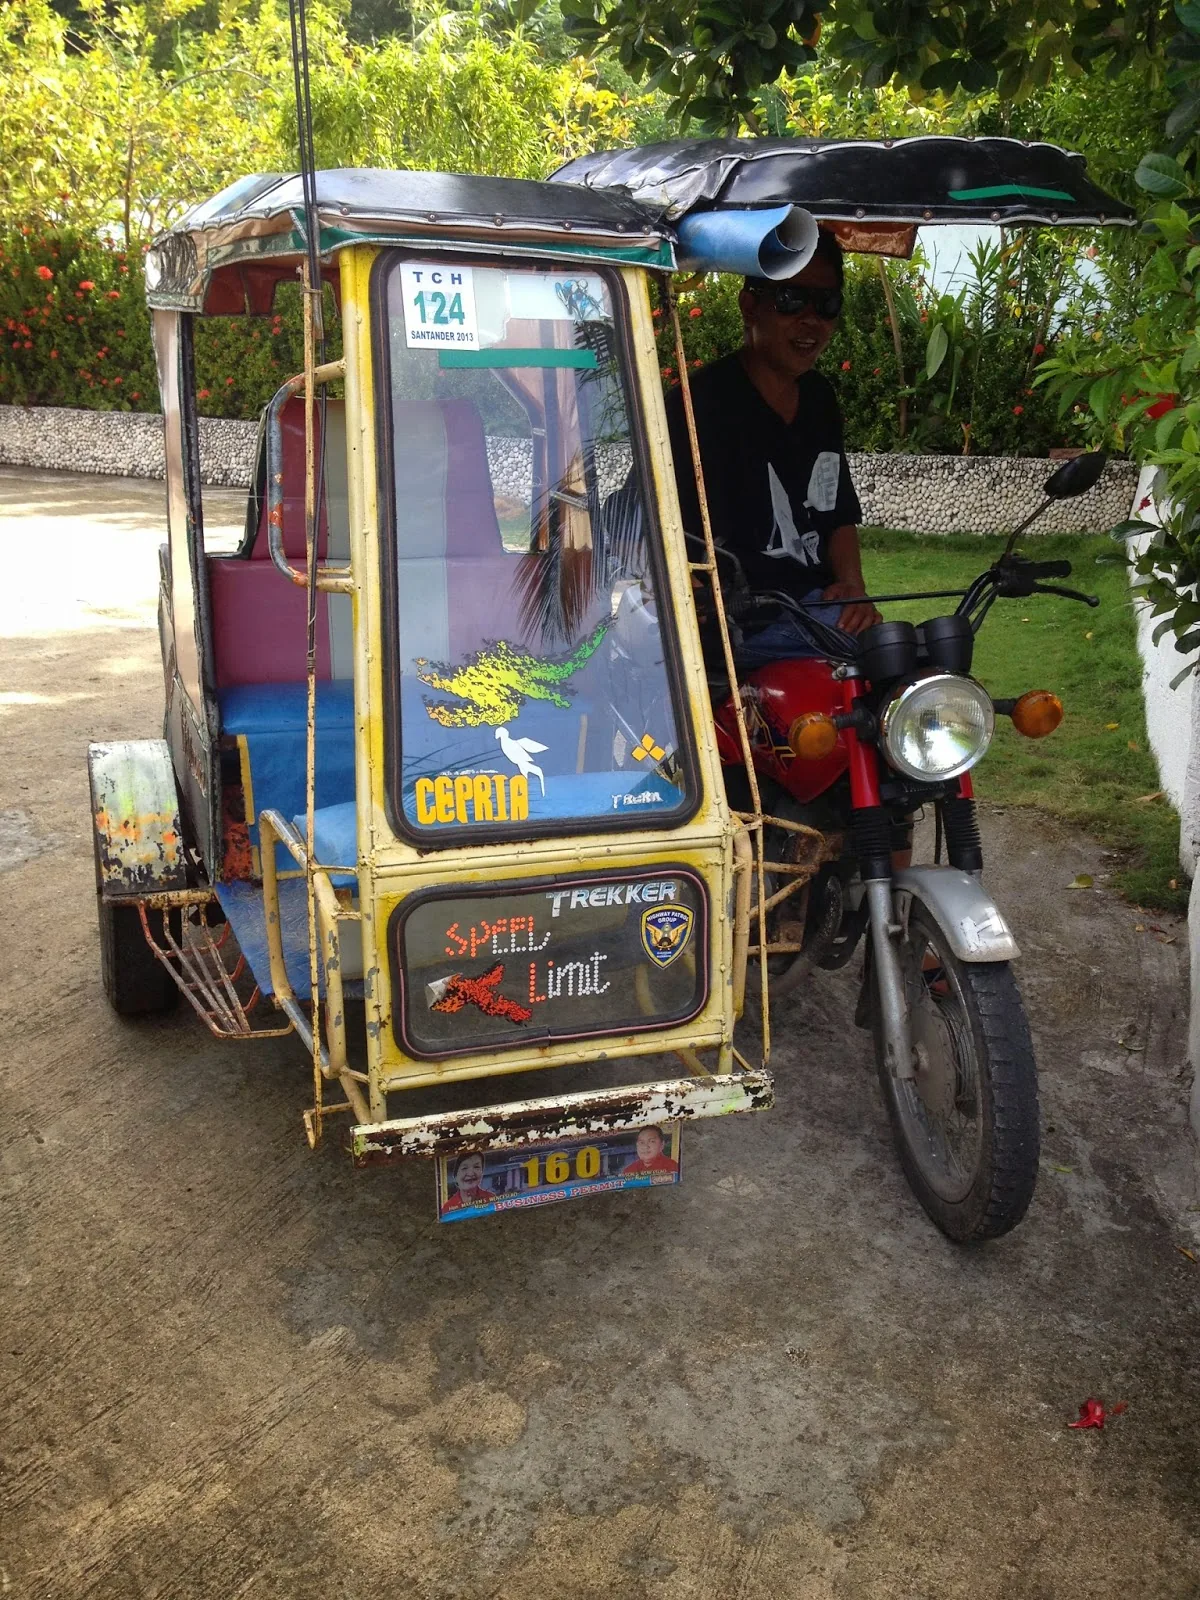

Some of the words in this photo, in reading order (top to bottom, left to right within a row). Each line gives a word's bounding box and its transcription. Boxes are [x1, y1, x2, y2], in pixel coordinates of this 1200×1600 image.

[413, 290, 465, 326] 124
[411, 330, 455, 342] SANTANDER
[456, 331, 474, 342] 2013
[546, 881, 678, 918] TREKKER
[646, 911, 670, 921] HIGHWAY
[671, 911, 689, 922] PATROL
[521, 1145, 601, 1188] 160
[494, 1189, 567, 1212] BUSINESS
[570, 1180, 626, 1197] PERMIT
